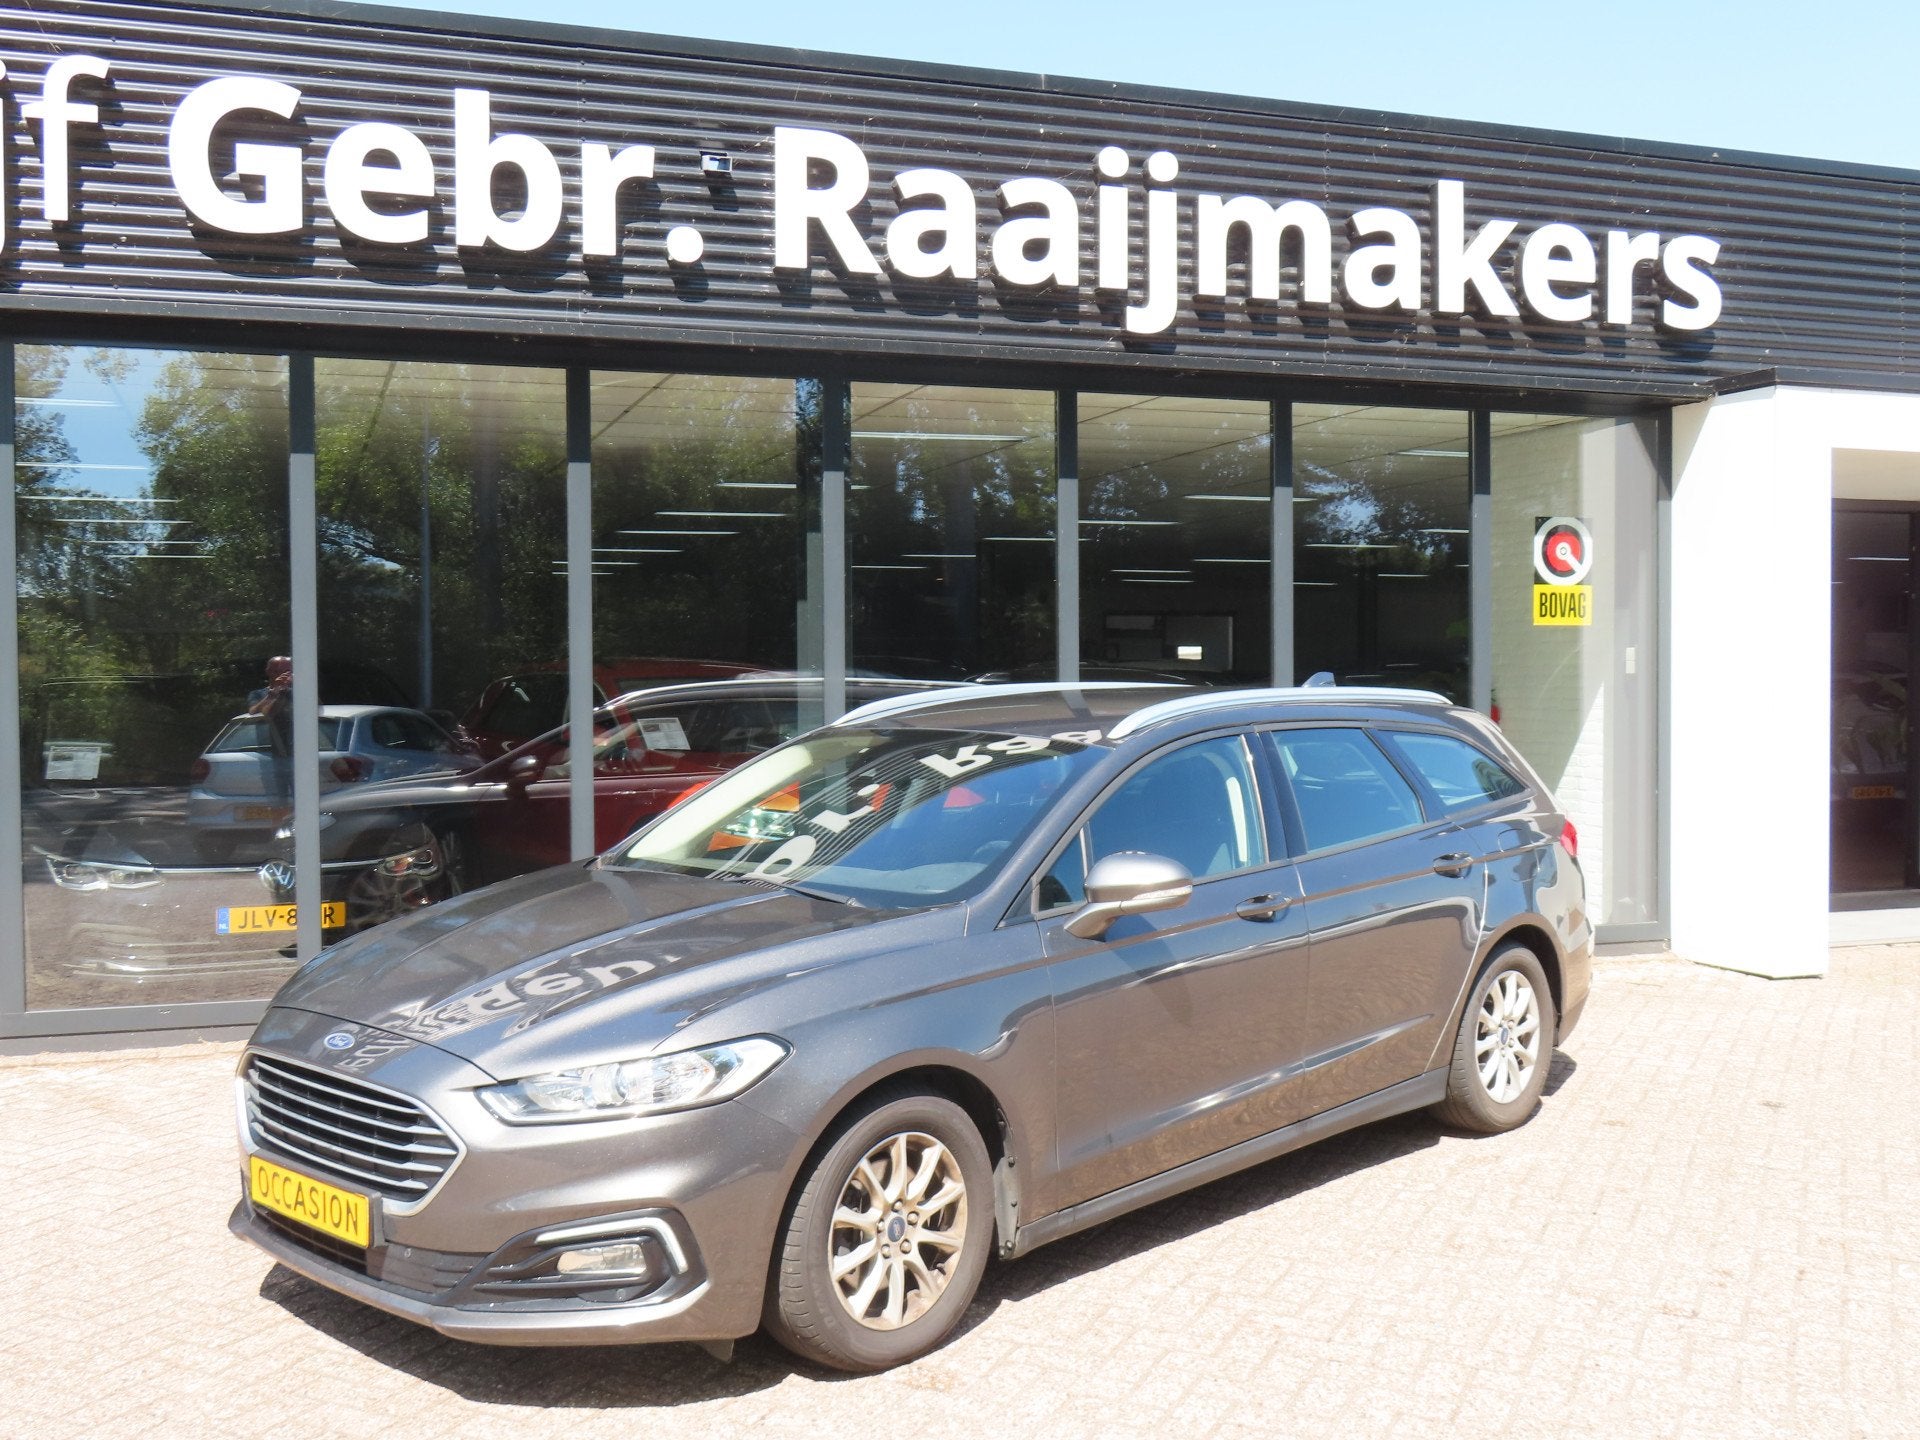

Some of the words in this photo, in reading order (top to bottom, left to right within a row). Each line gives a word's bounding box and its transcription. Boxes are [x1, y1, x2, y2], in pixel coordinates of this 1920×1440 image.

[168, 75, 704, 263] Gebr.
[774, 126, 1723, 334] Raaijmakers
[1539, 592, 1586, 618] BOVAG
[238, 906, 335, 929] JLV-8R
[258, 1165, 358, 1237] OCCASION
